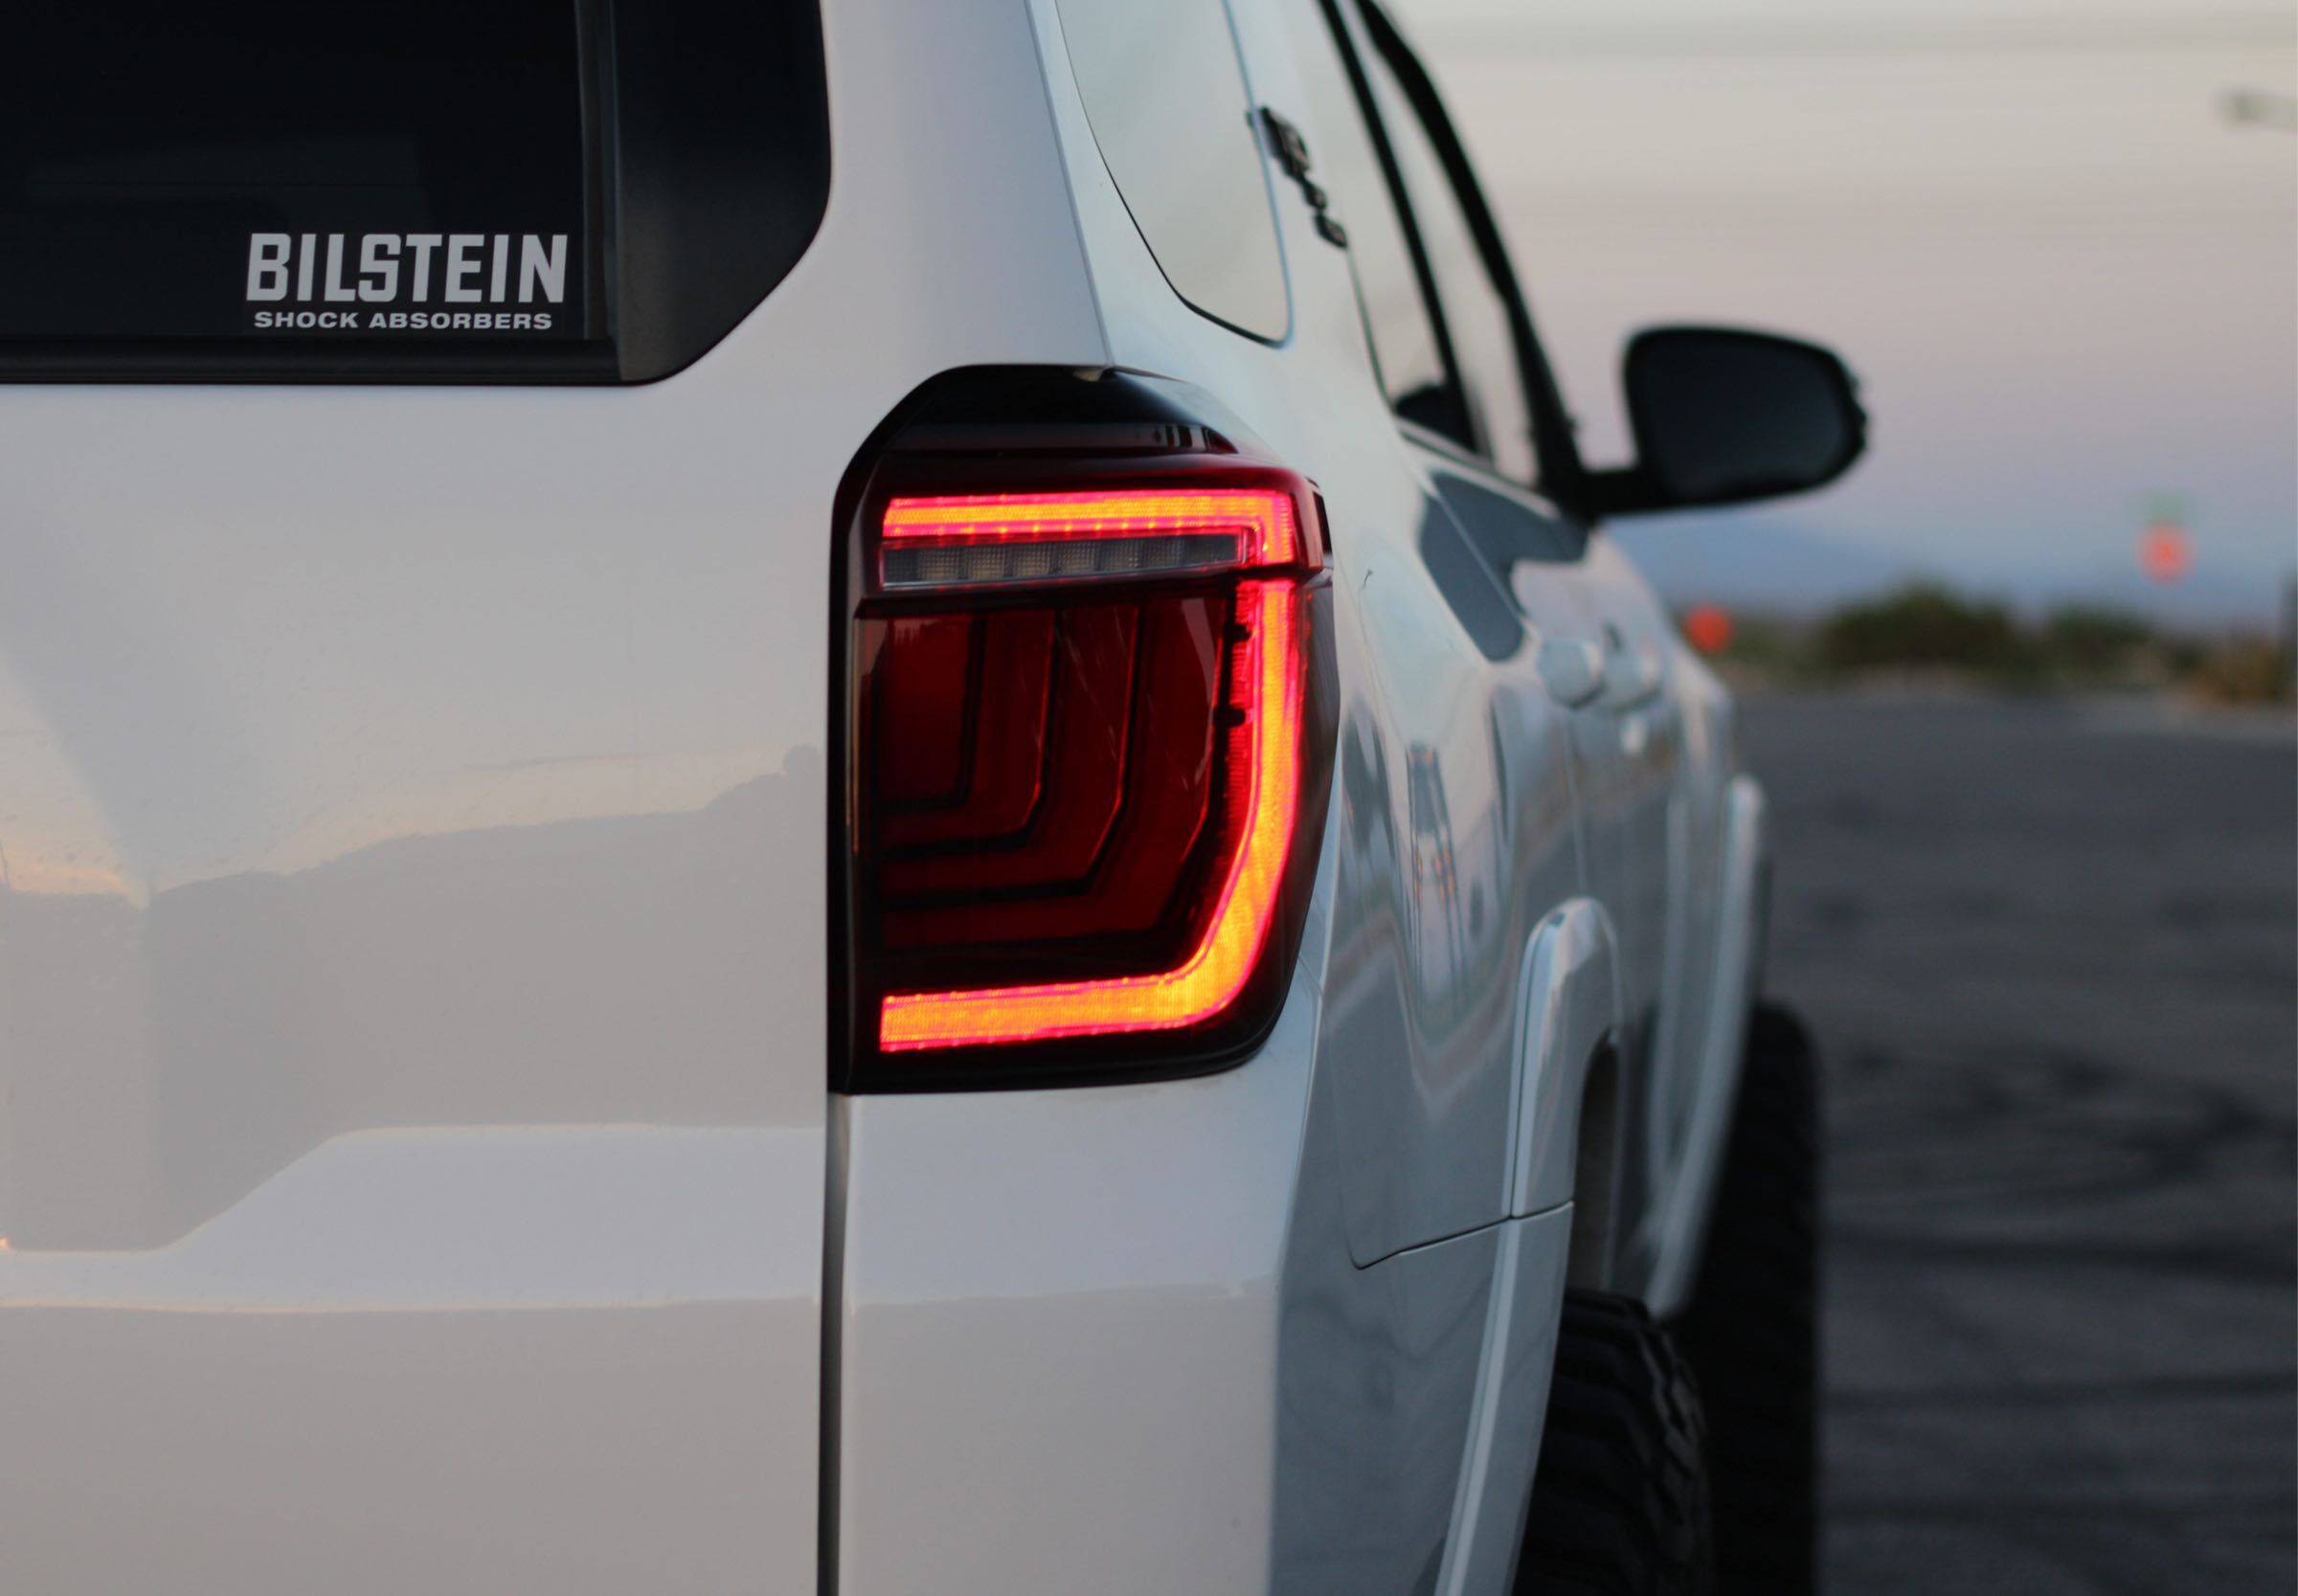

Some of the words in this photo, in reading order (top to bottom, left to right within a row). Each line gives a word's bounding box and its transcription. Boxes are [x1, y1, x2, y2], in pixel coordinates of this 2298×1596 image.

[246, 233, 568, 303] BILSTEIN
[254, 311, 359, 329] SHOCK
[369, 312, 552, 330] ABSORBERS
